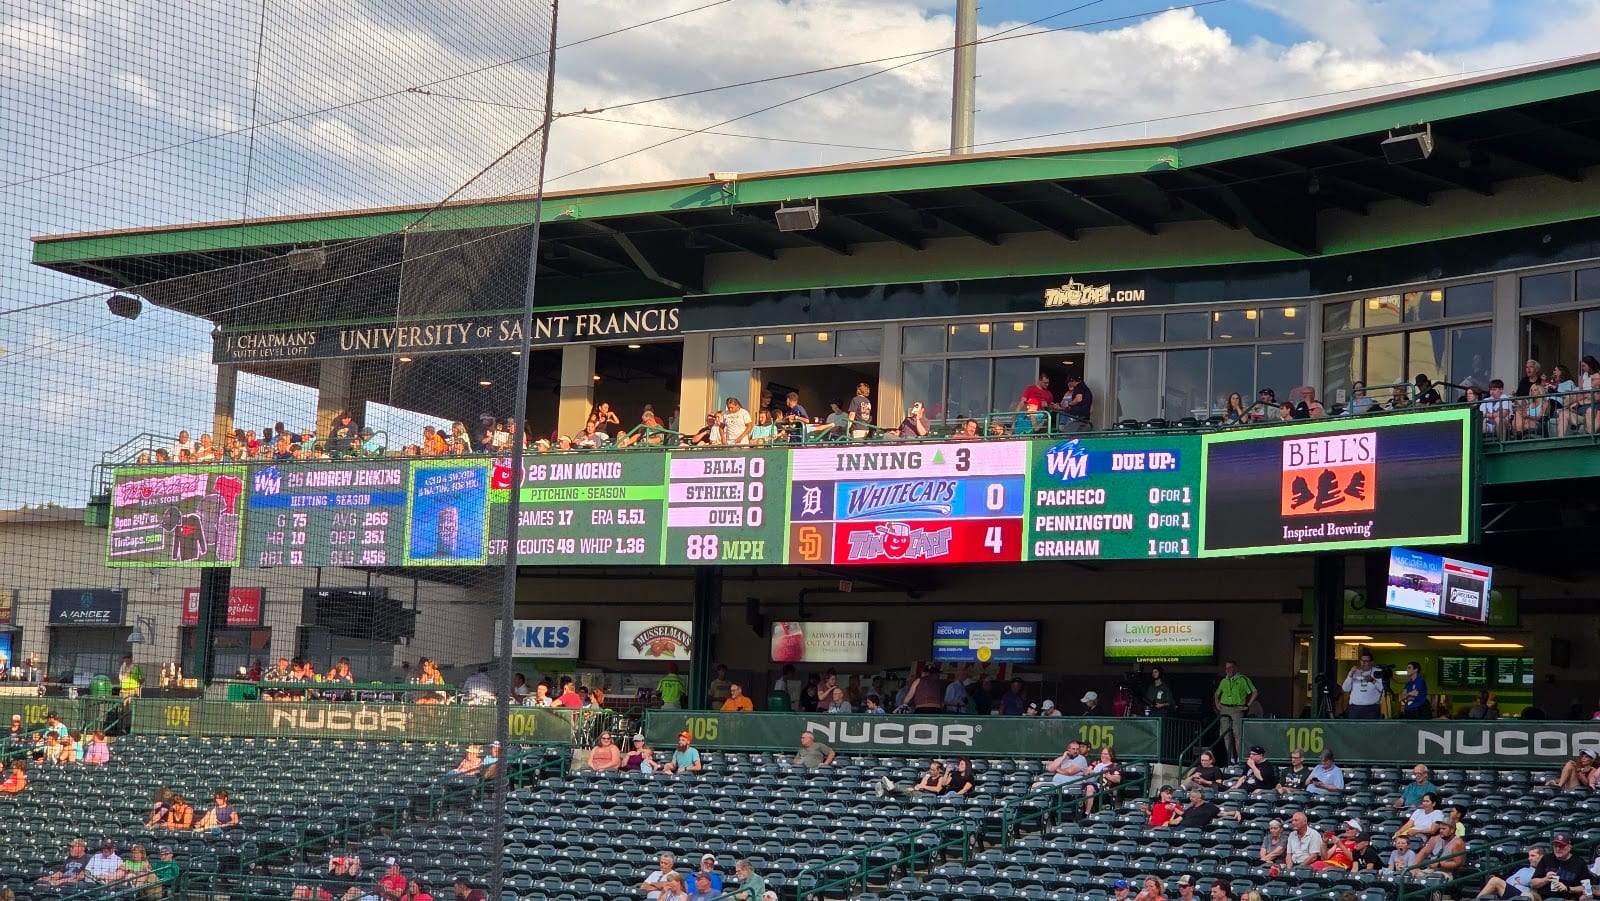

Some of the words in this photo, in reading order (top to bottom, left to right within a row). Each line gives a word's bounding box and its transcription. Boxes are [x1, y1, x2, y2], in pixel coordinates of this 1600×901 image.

[340, 323, 473, 351] UNIVERSITY
[476, 326, 493, 339] OF
[499, 316, 570, 341] SANT
[575, 308, 680, 336] FRANCIS
[237, 331, 317, 350] CHAPMAN'S
[287, 346, 308, 356] LOFT
[836, 451, 922, 472] INNING
[955, 448, 971, 472] 3
[1288, 436, 1371, 467] BELL'S
[529, 464, 547, 481] 26
[549, 463, 573, 480] IAN
[575, 461, 622, 480] KOENIG
[703, 459, 743, 475] BALL:
[749, 457, 765, 477] 0
[1111, 453, 1145, 471] DUE
[1148, 452, 1176, 469] UP:
[305, 470, 353, 487] ANDREW
[353, 468, 401, 487] JENKINS
[291, 495, 328, 507] HITTING
[336, 494, 371, 506] SEASON
[530, 488, 579, 501] PITCHING
[587, 487, 626, 499] SEASON
[686, 484, 742, 501] STRIKE:
[748, 481, 764, 502] 0
[848, 480, 957, 516] WHITECAPS
[985, 483, 1005, 511] 0
[1036, 489, 1106, 506] PACHECO
[1148, 487, 1160, 504] 0
[1160, 489, 1181, 502] FOR
[1181, 487, 1191, 503] 1
[115, 516, 132, 530] Open
[277, 514, 286, 527] G
[292, 513, 308, 527] 75
[332, 512, 357, 526] AVG
[362, 511, 389, 526] .266
[558, 509, 574, 526] 17
[591, 509, 613, 525] ERA
[617, 508, 646, 525] 5.51
[708, 509, 740, 525] OUT:
[747, 507, 762, 527] 0
[1035, 513, 1134, 532] PENNINGTON
[1147, 512, 1159, 529] 0
[1160, 514, 1180, 527] FOR
[1180, 512, 1191, 528] 1
[113, 533, 162, 548] TinCaps.com
[267, 531, 285, 545] HR
[291, 531, 306, 545] 10
[361, 530, 385, 544] .351
[984, 526, 1003, 554] 4
[1282, 524, 1326, 541] Inspired
[488, 538, 554, 555] STRKEOUTS
[556, 538, 575, 554] 49
[580, 538, 613, 554] WHIP
[615, 537, 646, 554] 1.36
[686, 534, 719, 560] 88
[722, 539, 765, 561] MPH
[1034, 540, 1100, 557] GRAHAM
[1147, 539, 1157, 555] 1
[1158, 541, 1179, 554] FOR
[1180, 539, 1190, 555] 1
[260, 551, 283, 565] RBI
[290, 550, 304, 565] 51
[24, 704, 49, 724] 103
[164, 705, 190, 727] 104
[273, 709, 407, 732] NUCOR
[508, 713, 536, 736] 104
[686, 717, 719, 741] 105
[805, 721, 974, 747] NUCOR
[1079, 725, 1114, 750] 105
[1286, 727, 1325, 753] 106
